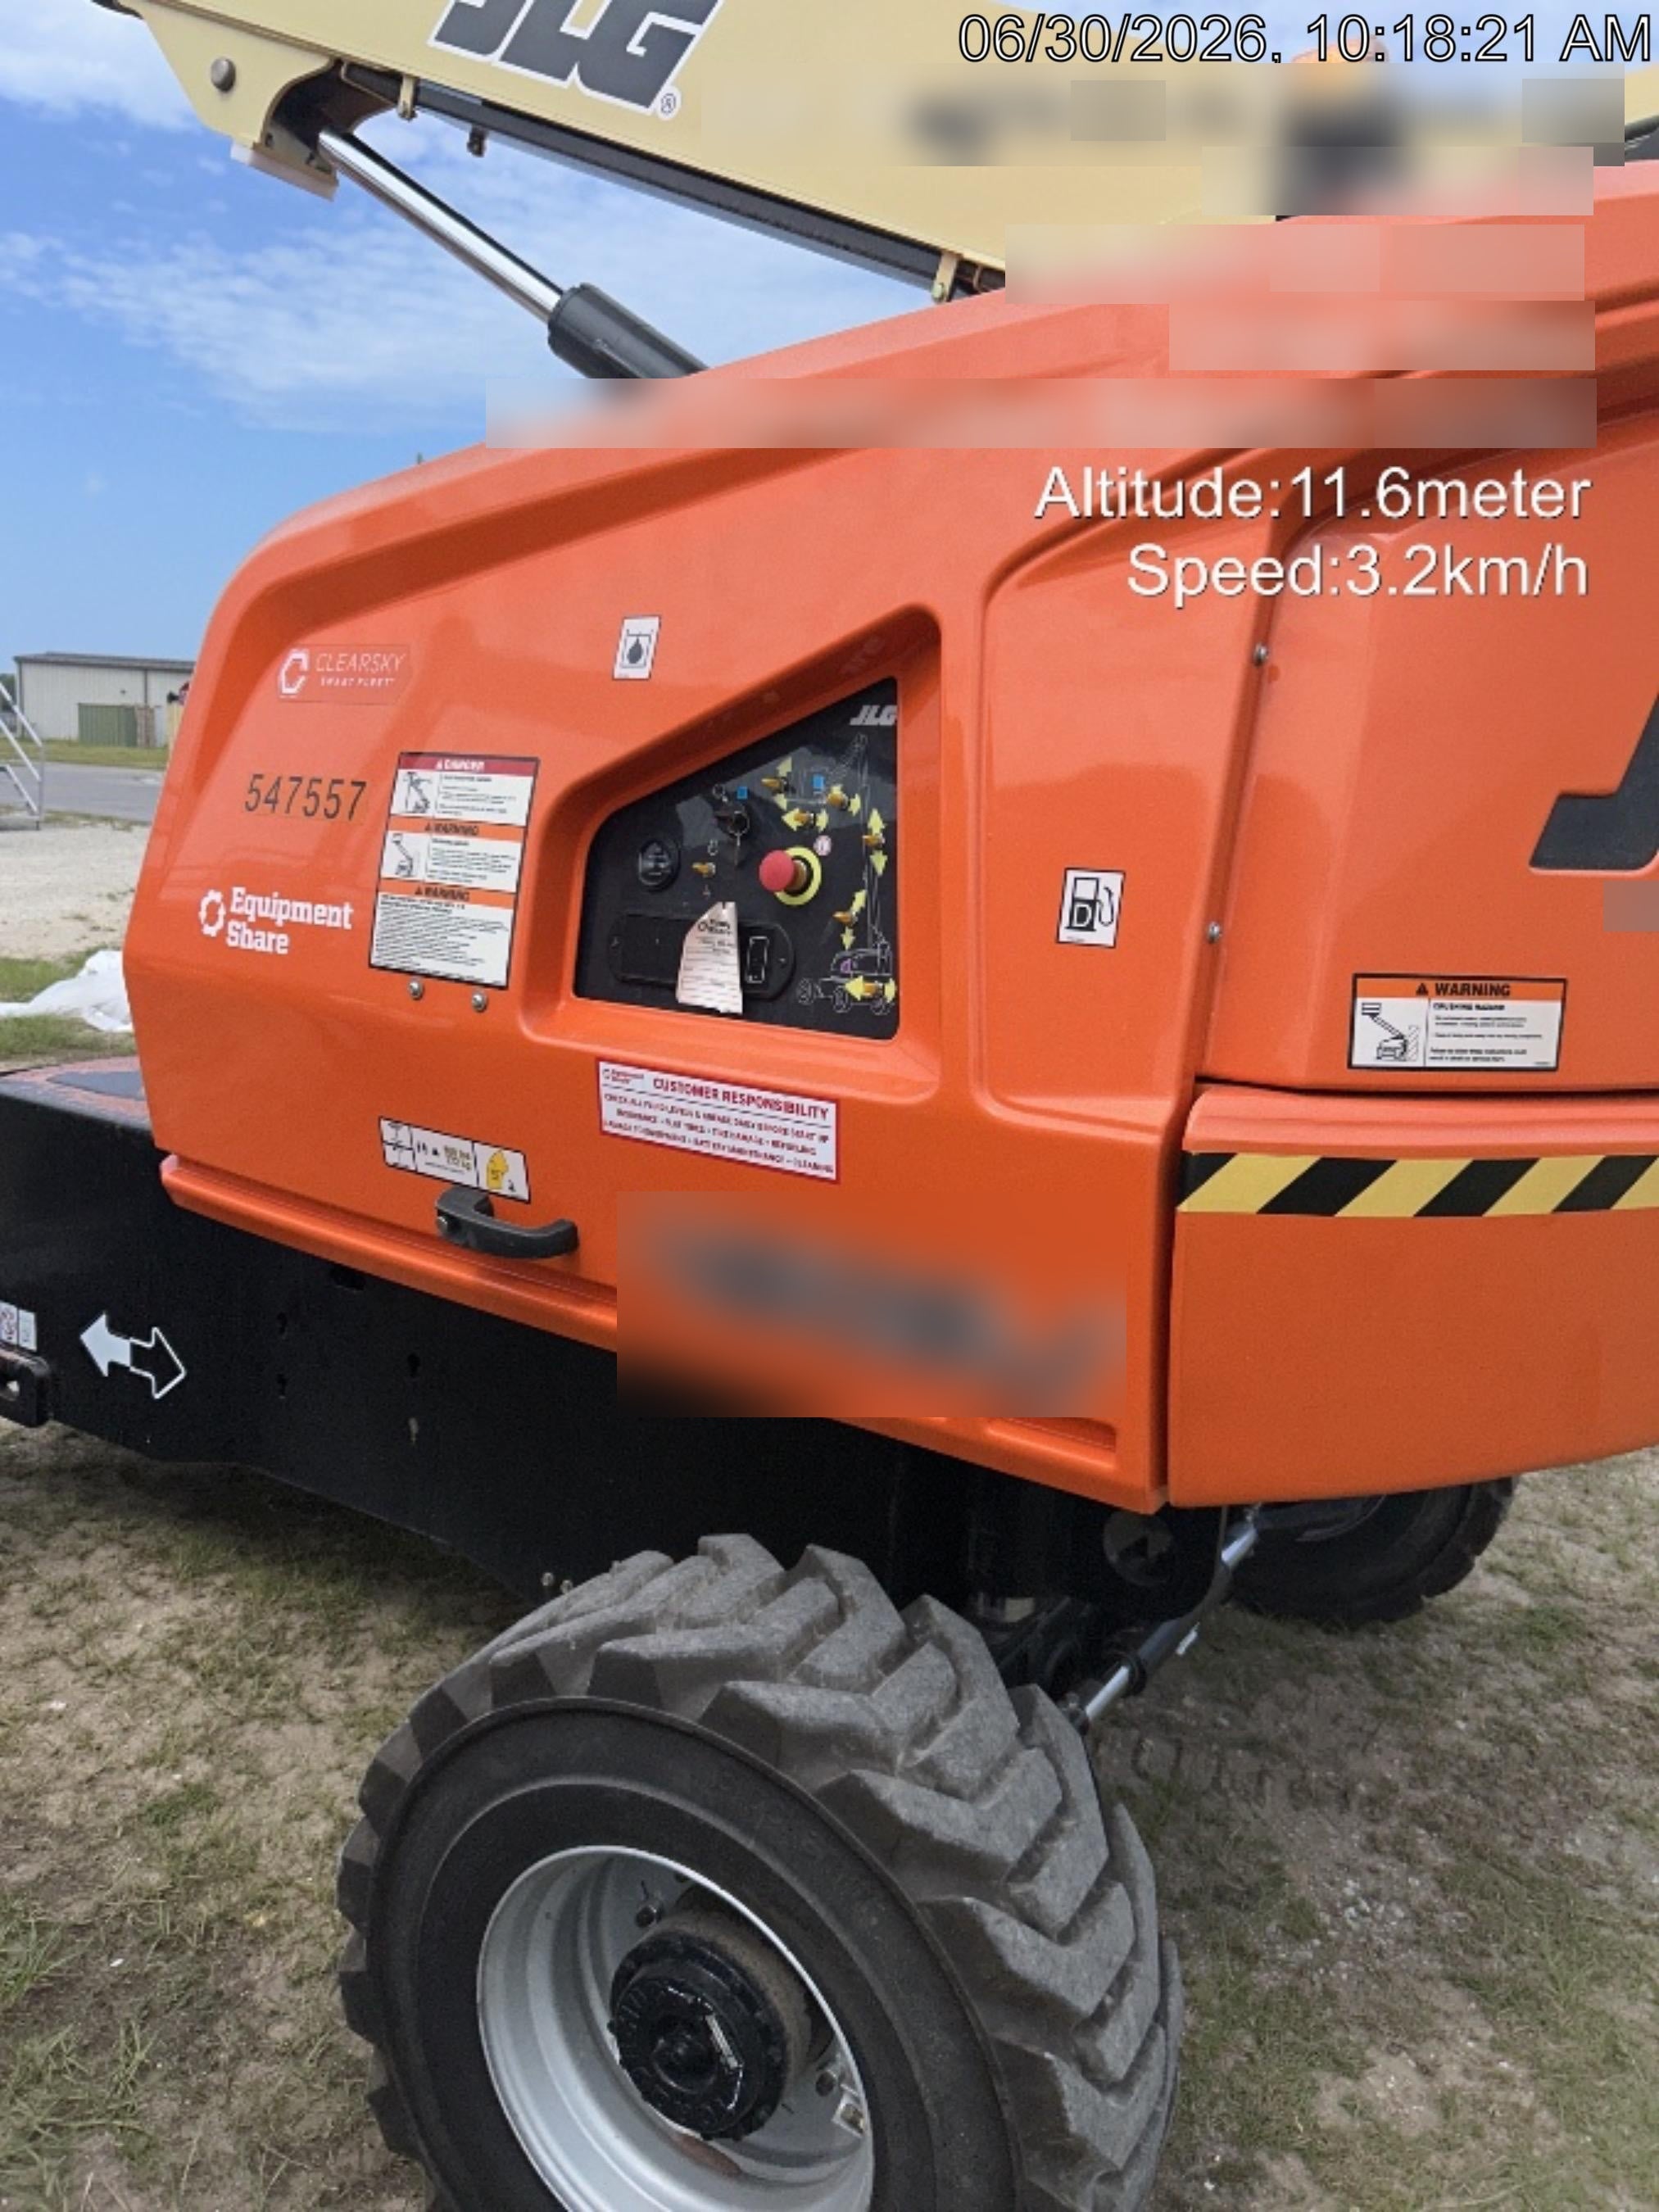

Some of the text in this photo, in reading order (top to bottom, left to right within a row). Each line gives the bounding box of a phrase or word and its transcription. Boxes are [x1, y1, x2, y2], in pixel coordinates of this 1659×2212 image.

[315, 652, 406, 673] CLEARSKY
[850, 705, 899, 726] JLG
[245, 773, 368, 821] 547557
[229, 886, 354, 931] Equipment
[225, 920, 290, 955] Share
[1435, 982, 1511, 997] WARNING
[654, 1077, 719, 1101] CUSTOMER
[722, 1090, 829, 1121] RESPONSIBILITY
